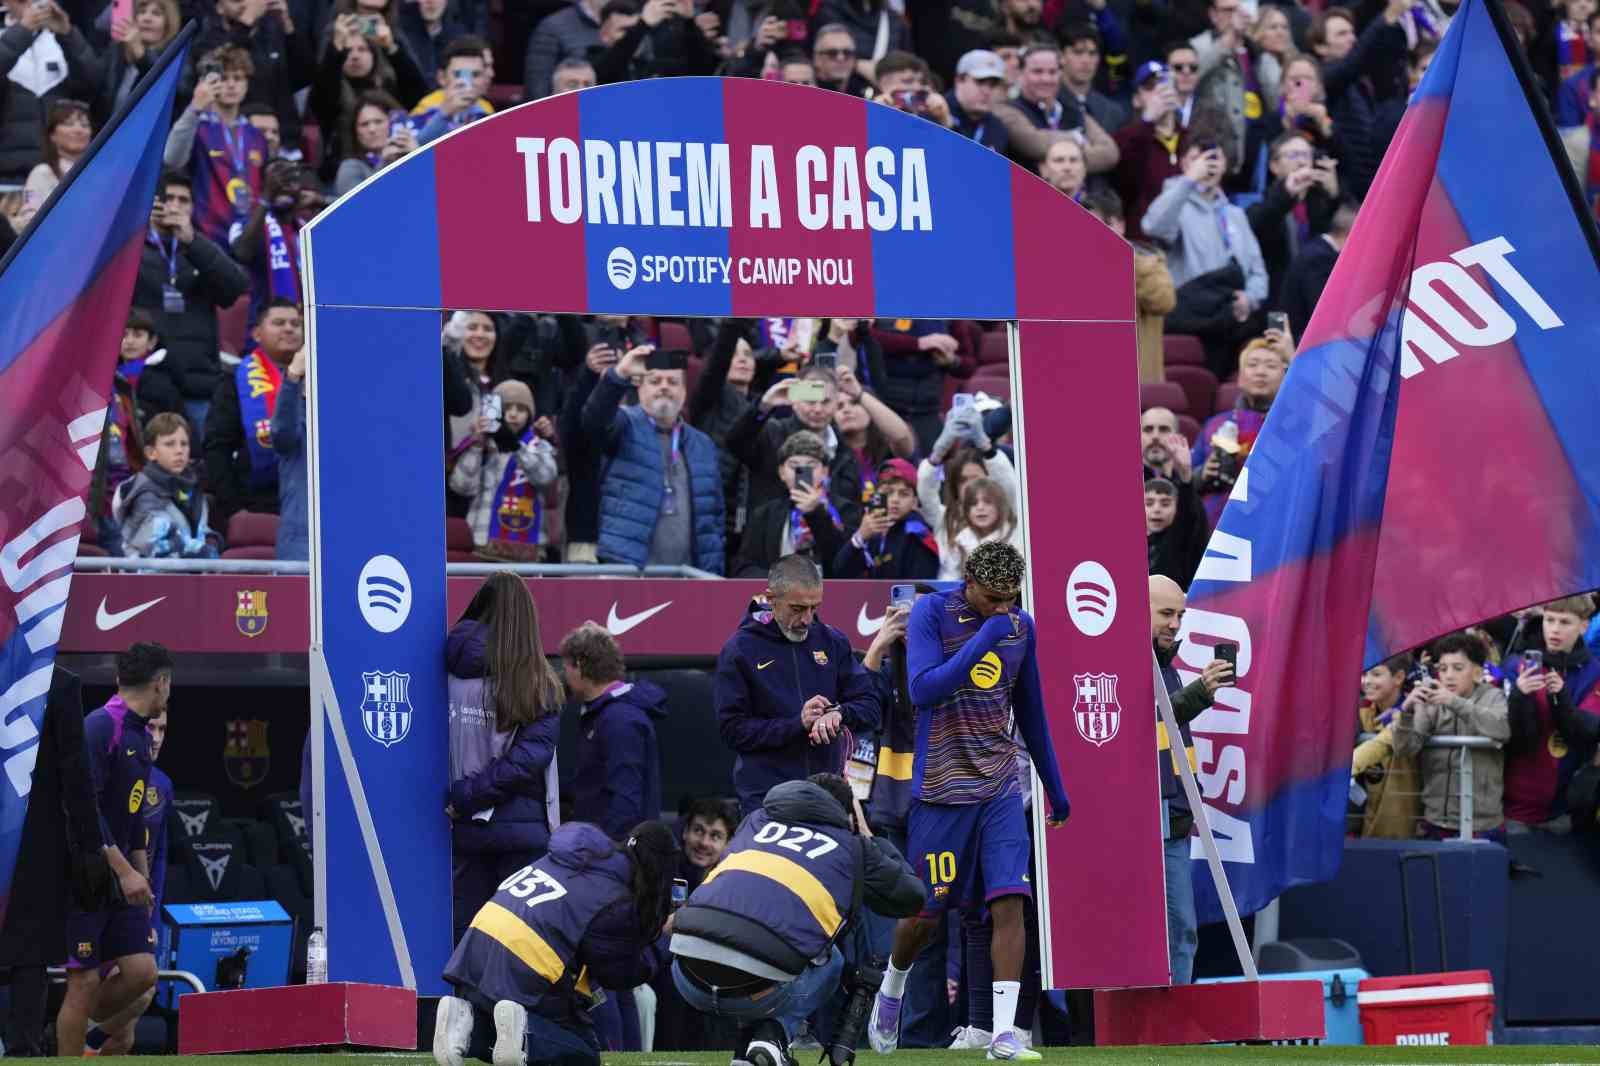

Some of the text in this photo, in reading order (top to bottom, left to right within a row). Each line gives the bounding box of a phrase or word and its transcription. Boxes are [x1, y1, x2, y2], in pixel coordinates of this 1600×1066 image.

[515, 136, 933, 232] TORNEM A CASA
[641, 254, 853, 287] SPOTIFY CAMP NOU
[377, 702, 396, 711] FCB
[1088, 703, 1106, 712] FCB
[753, 821, 839, 859] 027
[925, 851, 956, 884] 10
[497, 865, 568, 908] 037
